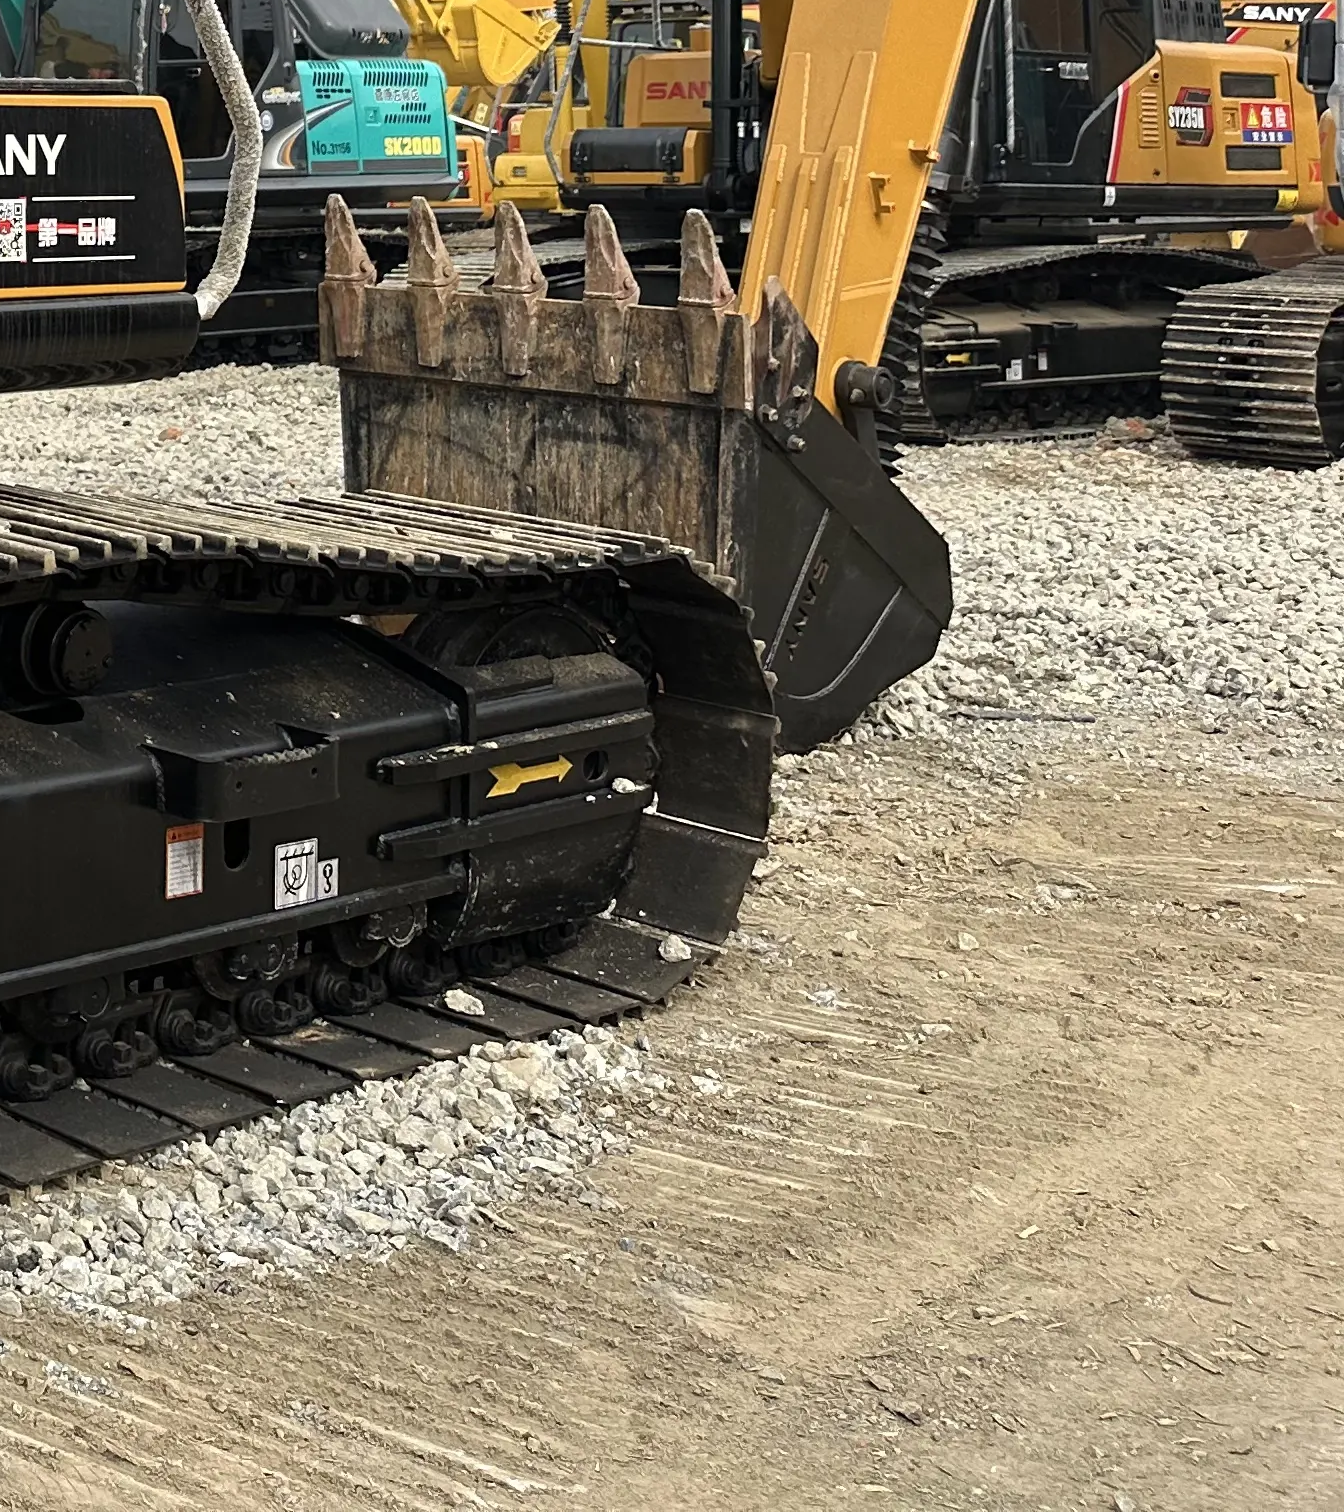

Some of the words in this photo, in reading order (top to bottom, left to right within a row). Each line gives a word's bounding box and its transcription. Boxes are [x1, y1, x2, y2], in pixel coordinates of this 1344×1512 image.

[1242, 5, 1311, 23] SANY
[645, 80, 712, 100] SAN
[1260, 105, 1287, 128] 危险
[37, 217, 117, 248] 第一品牌
[784, 554, 830, 663] SANY
